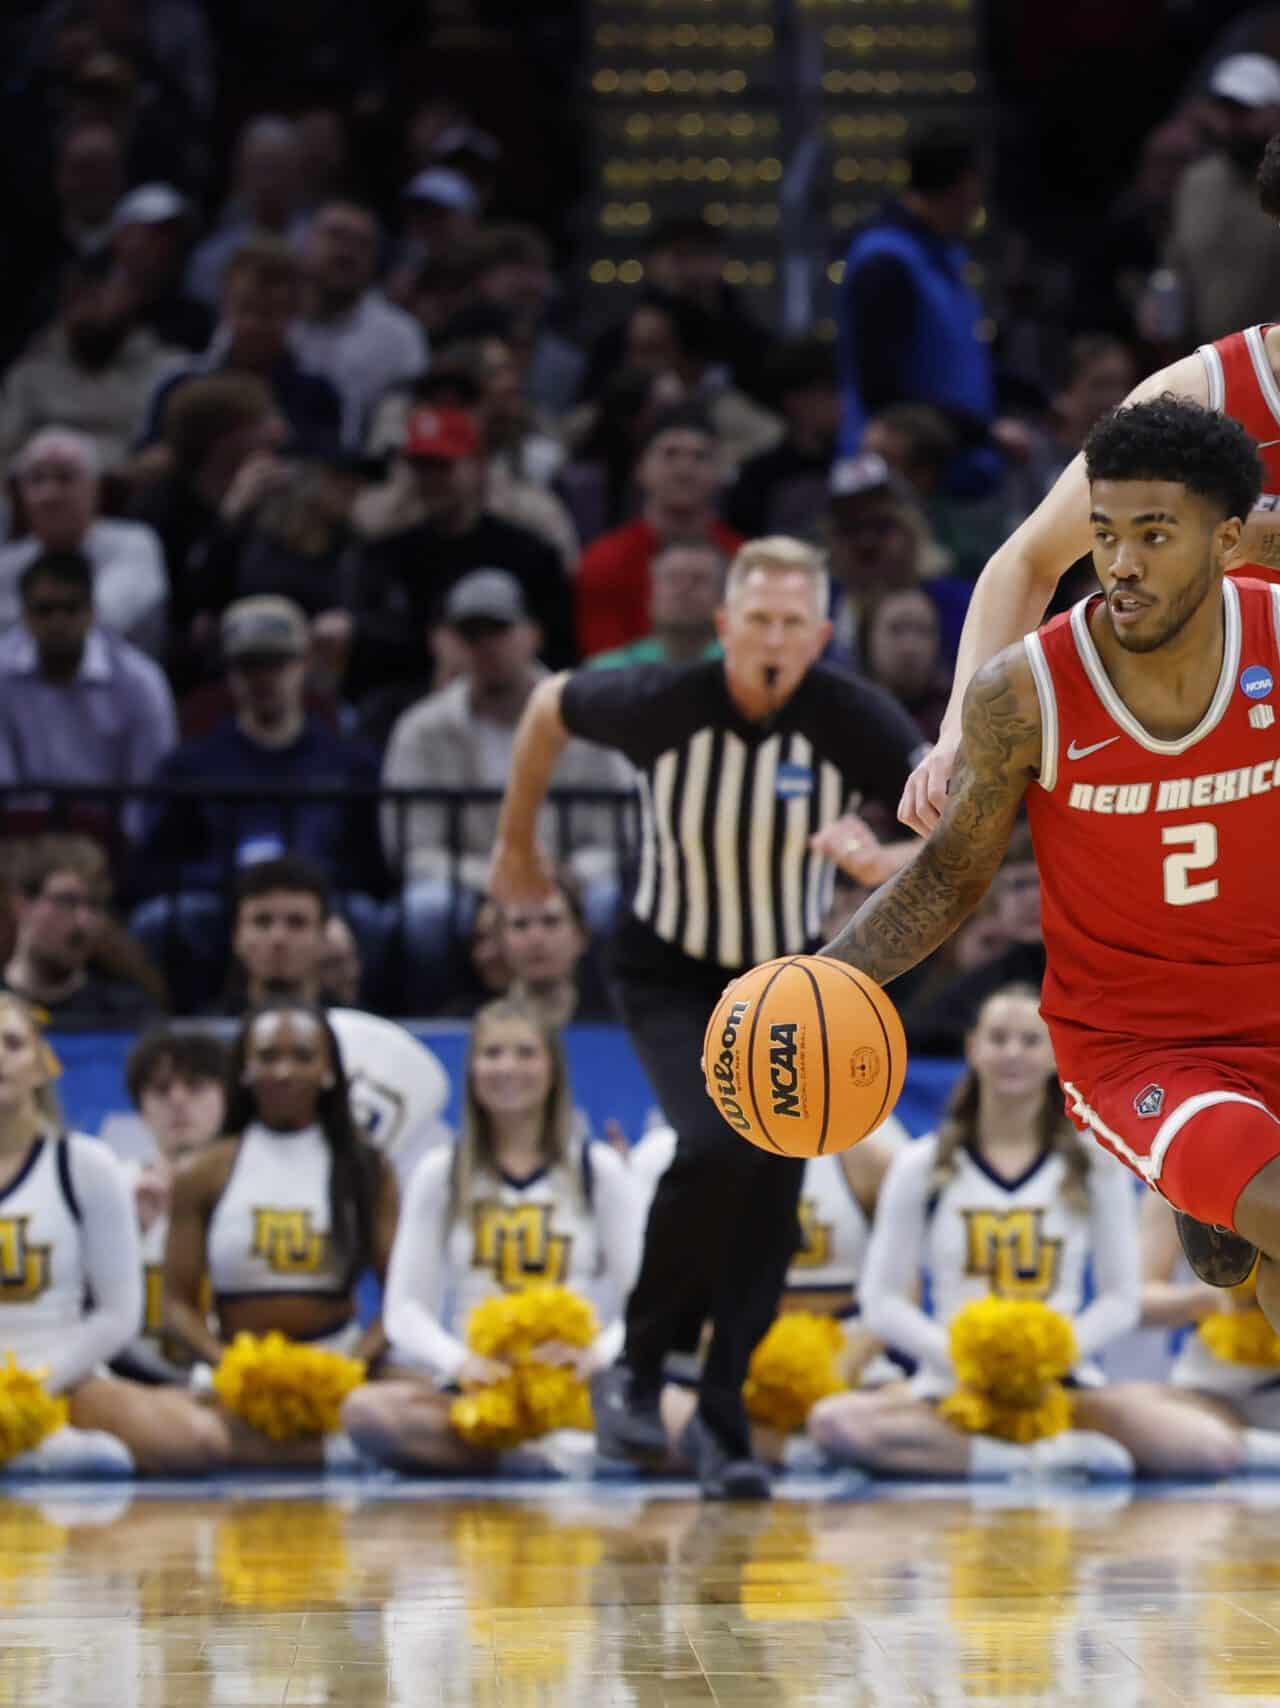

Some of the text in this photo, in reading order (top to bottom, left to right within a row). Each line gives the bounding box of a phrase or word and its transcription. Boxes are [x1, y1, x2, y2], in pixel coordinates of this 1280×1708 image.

[1068, 783, 1153, 815] NEW
[1161, 821, 1219, 906] 2
[713, 1000, 752, 1131] Wilson
[769, 1022, 800, 1119] NCAA
[474, 1203, 571, 1291] MU
[962, 1207, 1063, 1301] MU
